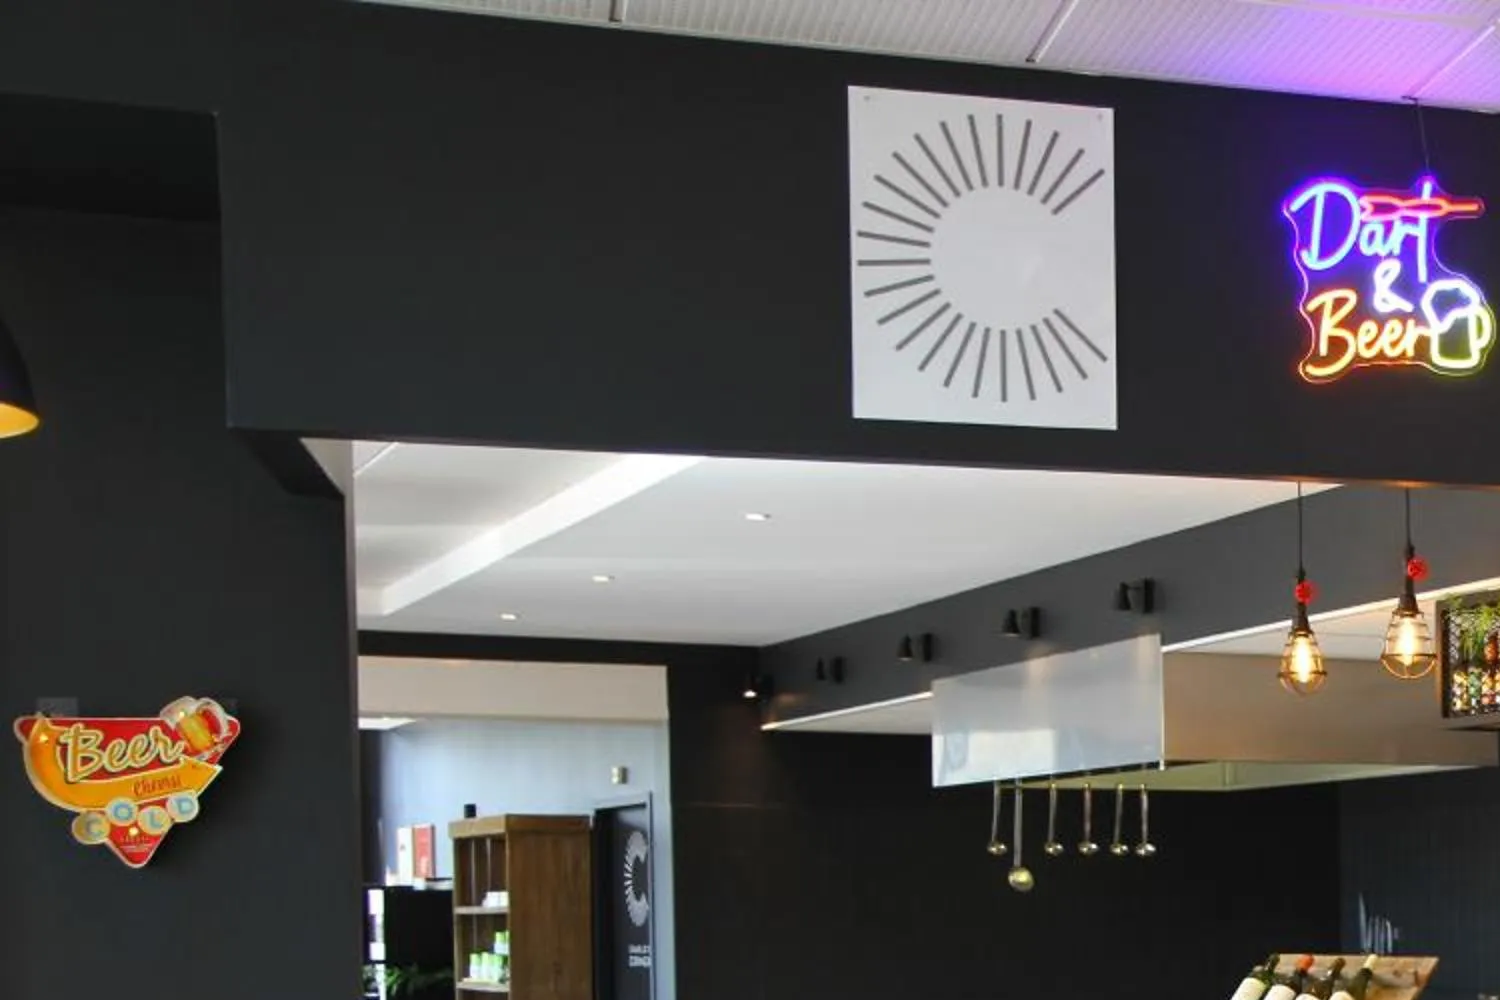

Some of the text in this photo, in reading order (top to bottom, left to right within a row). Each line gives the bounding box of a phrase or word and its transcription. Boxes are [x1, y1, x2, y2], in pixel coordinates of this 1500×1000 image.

[1290, 182, 1432, 282] Dart
[1374, 258, 1415, 313] &
[1306, 288, 1432, 377] Beer
[58, 722, 184, 784] Beer
